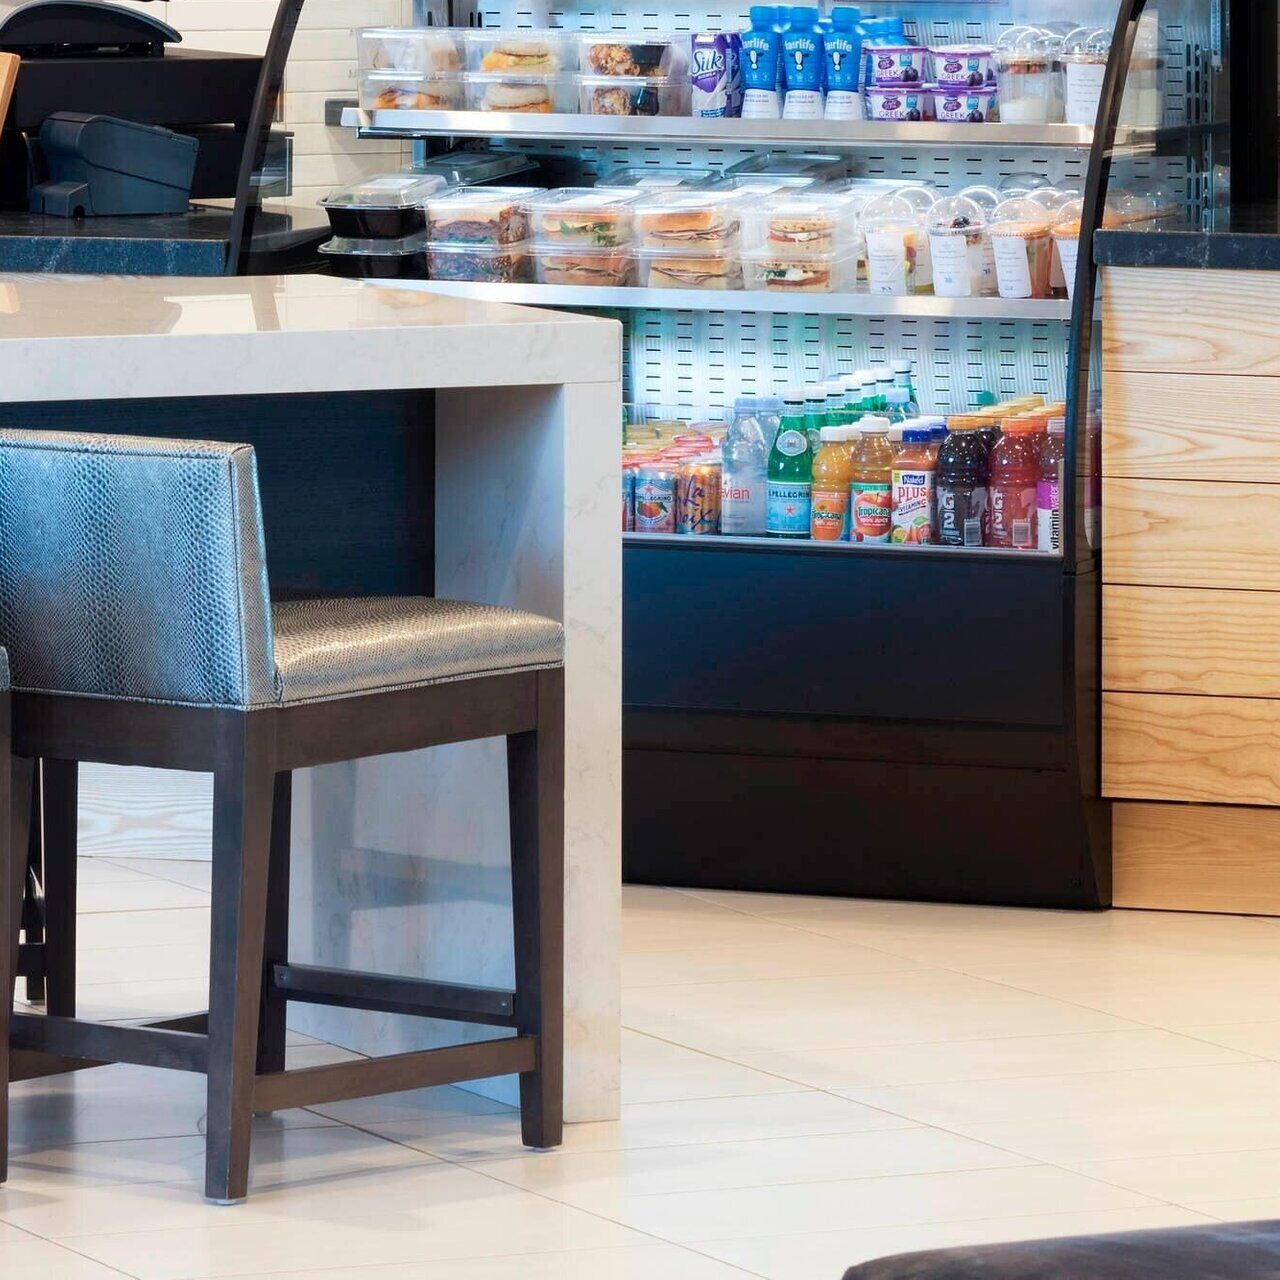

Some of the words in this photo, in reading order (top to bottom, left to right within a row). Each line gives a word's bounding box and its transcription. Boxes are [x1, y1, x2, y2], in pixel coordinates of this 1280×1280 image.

[784, 39, 815, 51] fairlife
[693, 50, 724, 73] Silk
[898, 486, 927, 503] PLUS
[813, 511, 842, 520] Tropicana
[857, 506, 892, 518] Tropicana
[1050, 485, 1060, 550] vitaminwater
